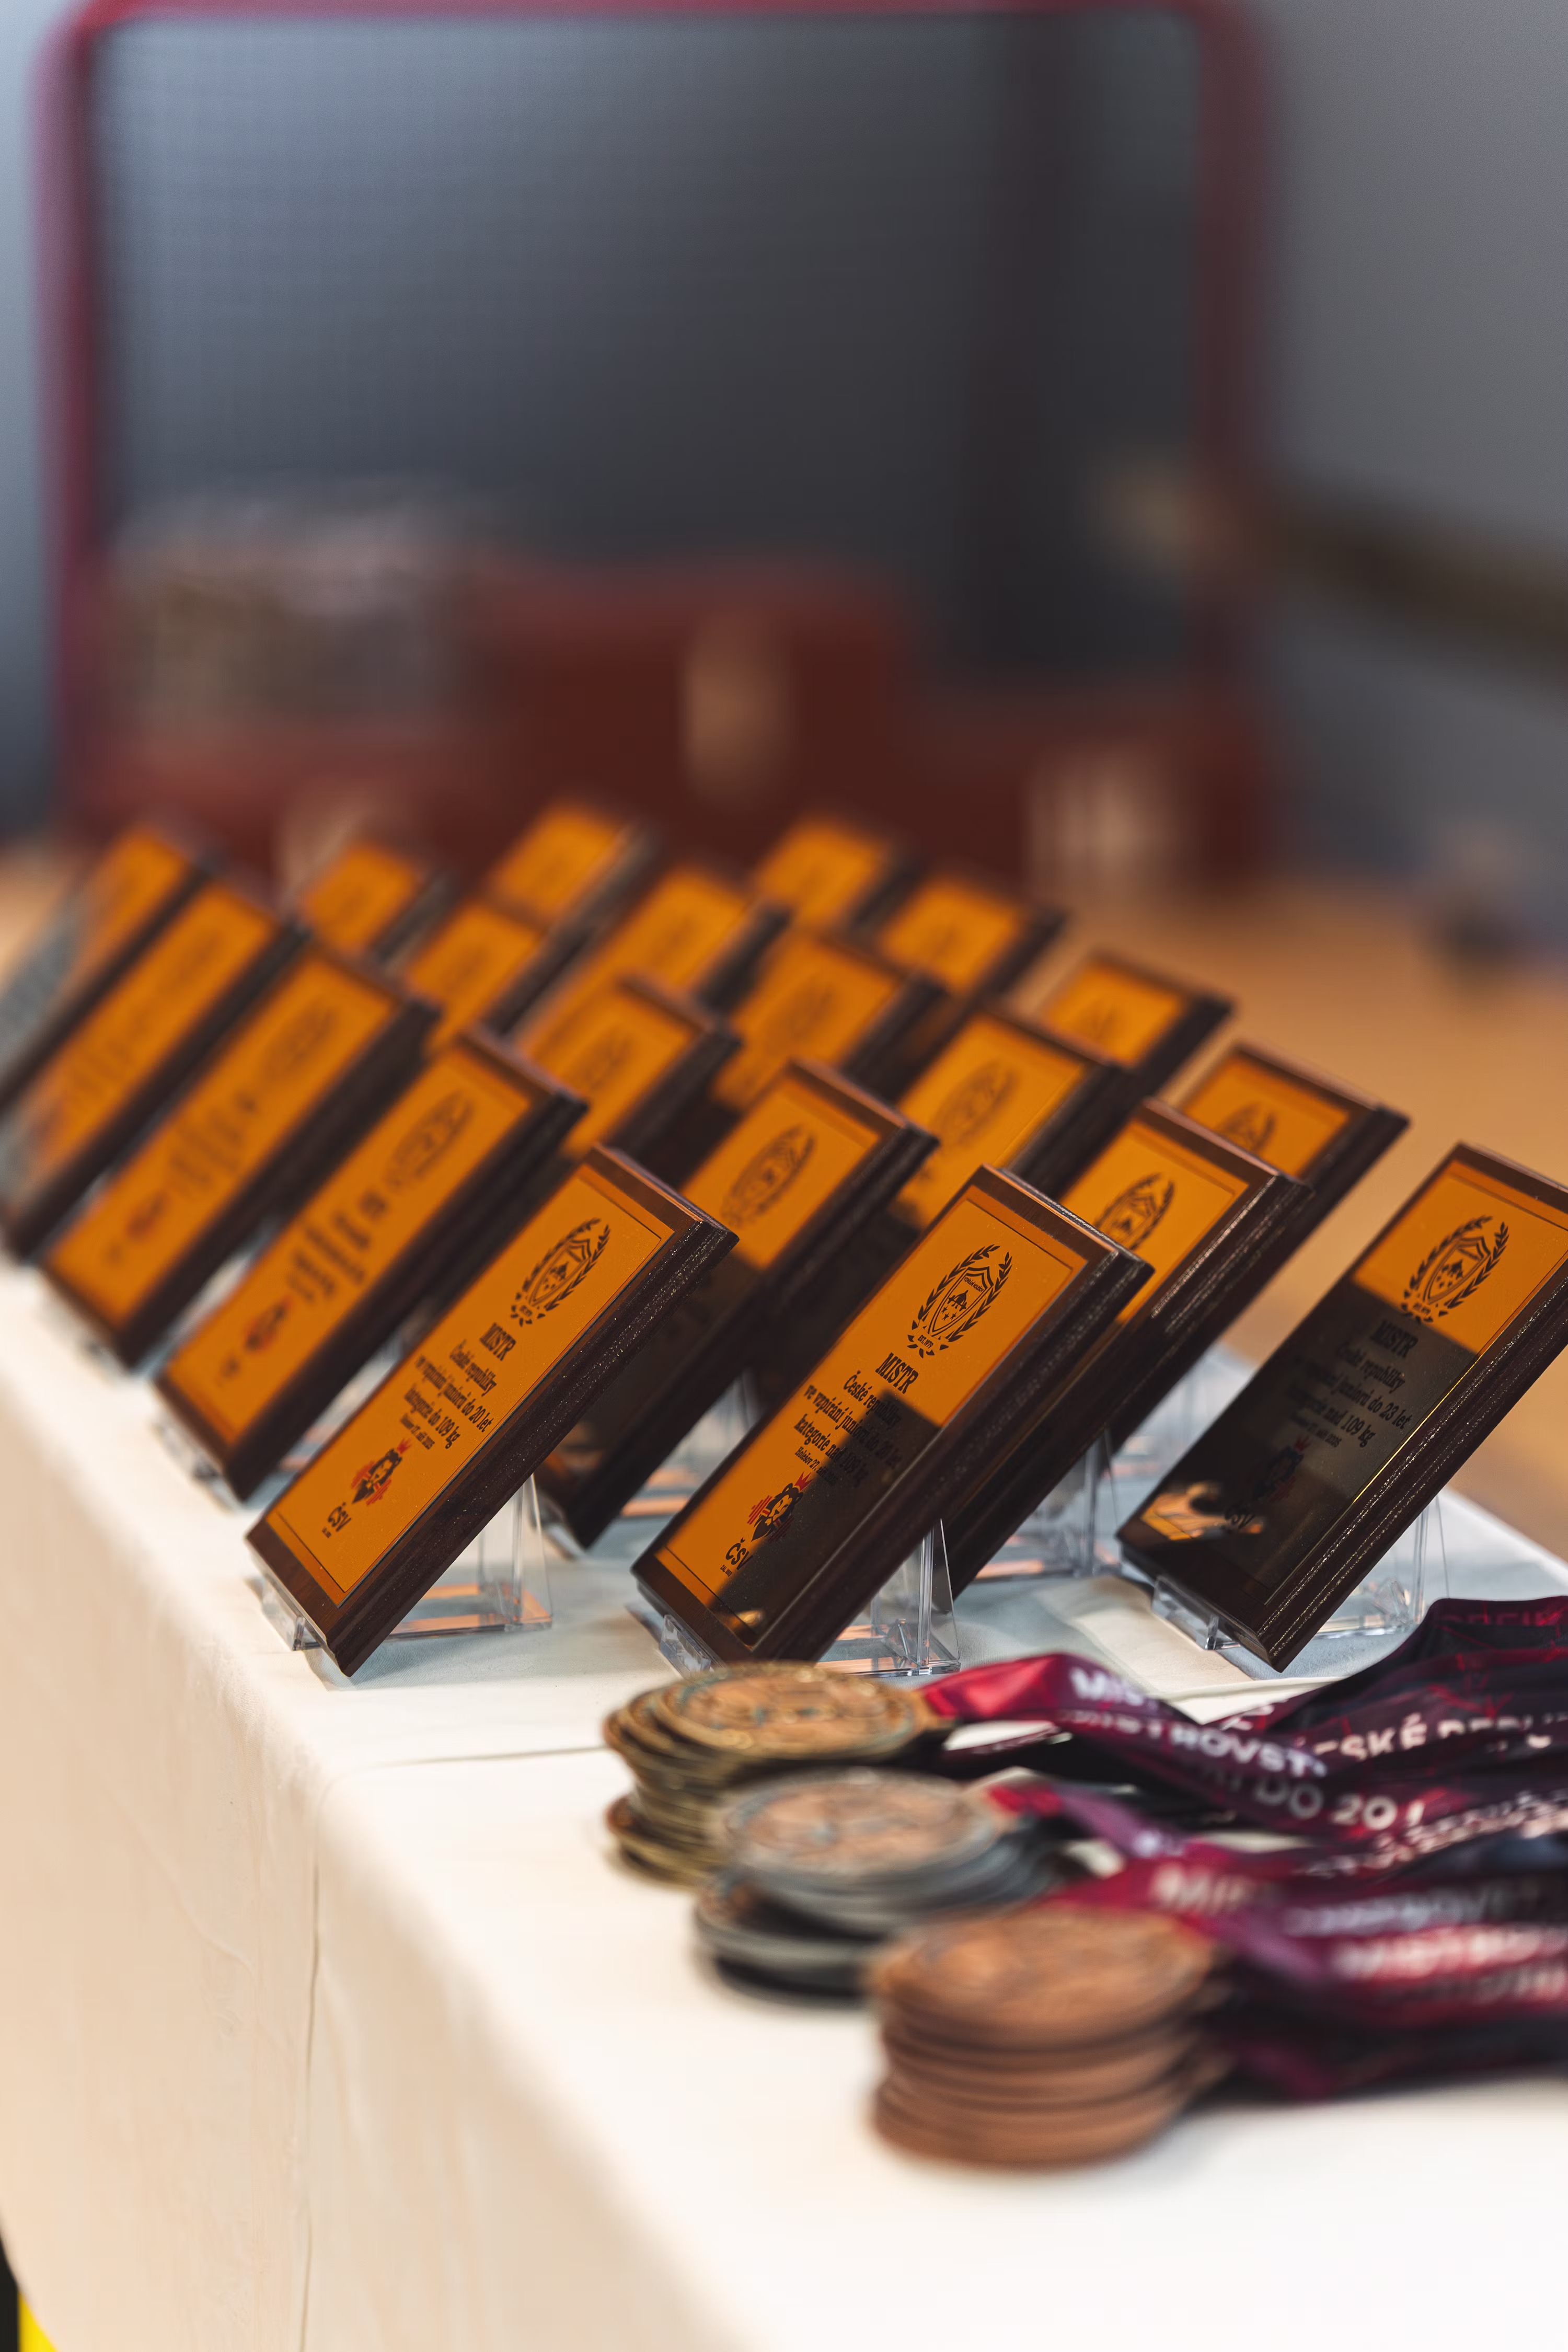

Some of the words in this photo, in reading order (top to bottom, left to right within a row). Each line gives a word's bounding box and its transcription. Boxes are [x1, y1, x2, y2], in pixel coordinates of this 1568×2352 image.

[480, 1322, 516, 1361] MISTR
[923, 1339, 934, 1349] 1979
[1369, 1320, 1419, 1358] MISTR
[465, 1363, 497, 1397] republiky
[874, 1352, 919, 1394] MISTR
[1359, 1361, 1405, 1394] republiky
[461, 1398, 476, 1416] do
[468, 1405, 486, 1424] 20
[803, 1384, 817, 1400] ve
[812, 1392, 849, 1423] vzpírání
[834, 1410, 872, 1444] juniorů
[843, 1369, 873, 1402] České
[863, 1394, 903, 1429] republiky
[1367, 1396, 1383, 1413] do
[1379, 1401, 1398, 1421] 23
[1392, 1409, 1413, 1430] let
[428, 1408, 442, 1426] do
[435, 1416, 455, 1437] 109
[445, 1426, 460, 1449] kg
[476, 1412, 494, 1433] let
[1323, 1407, 1347, 1426] nad
[1341, 1414, 1365, 1435] 109
[1357, 1424, 1376, 1448] kg
[794, 1413, 831, 1451] kategorie
[825, 1444, 848, 1463] nad
[839, 1452, 862, 1474] 109
[794, 1446, 813, 1465] Holešov
[327, 1501, 352, 1532] ČSV
[725, 1537, 753, 1570] ČSV
[1331, 1793, 1398, 1830] 20
